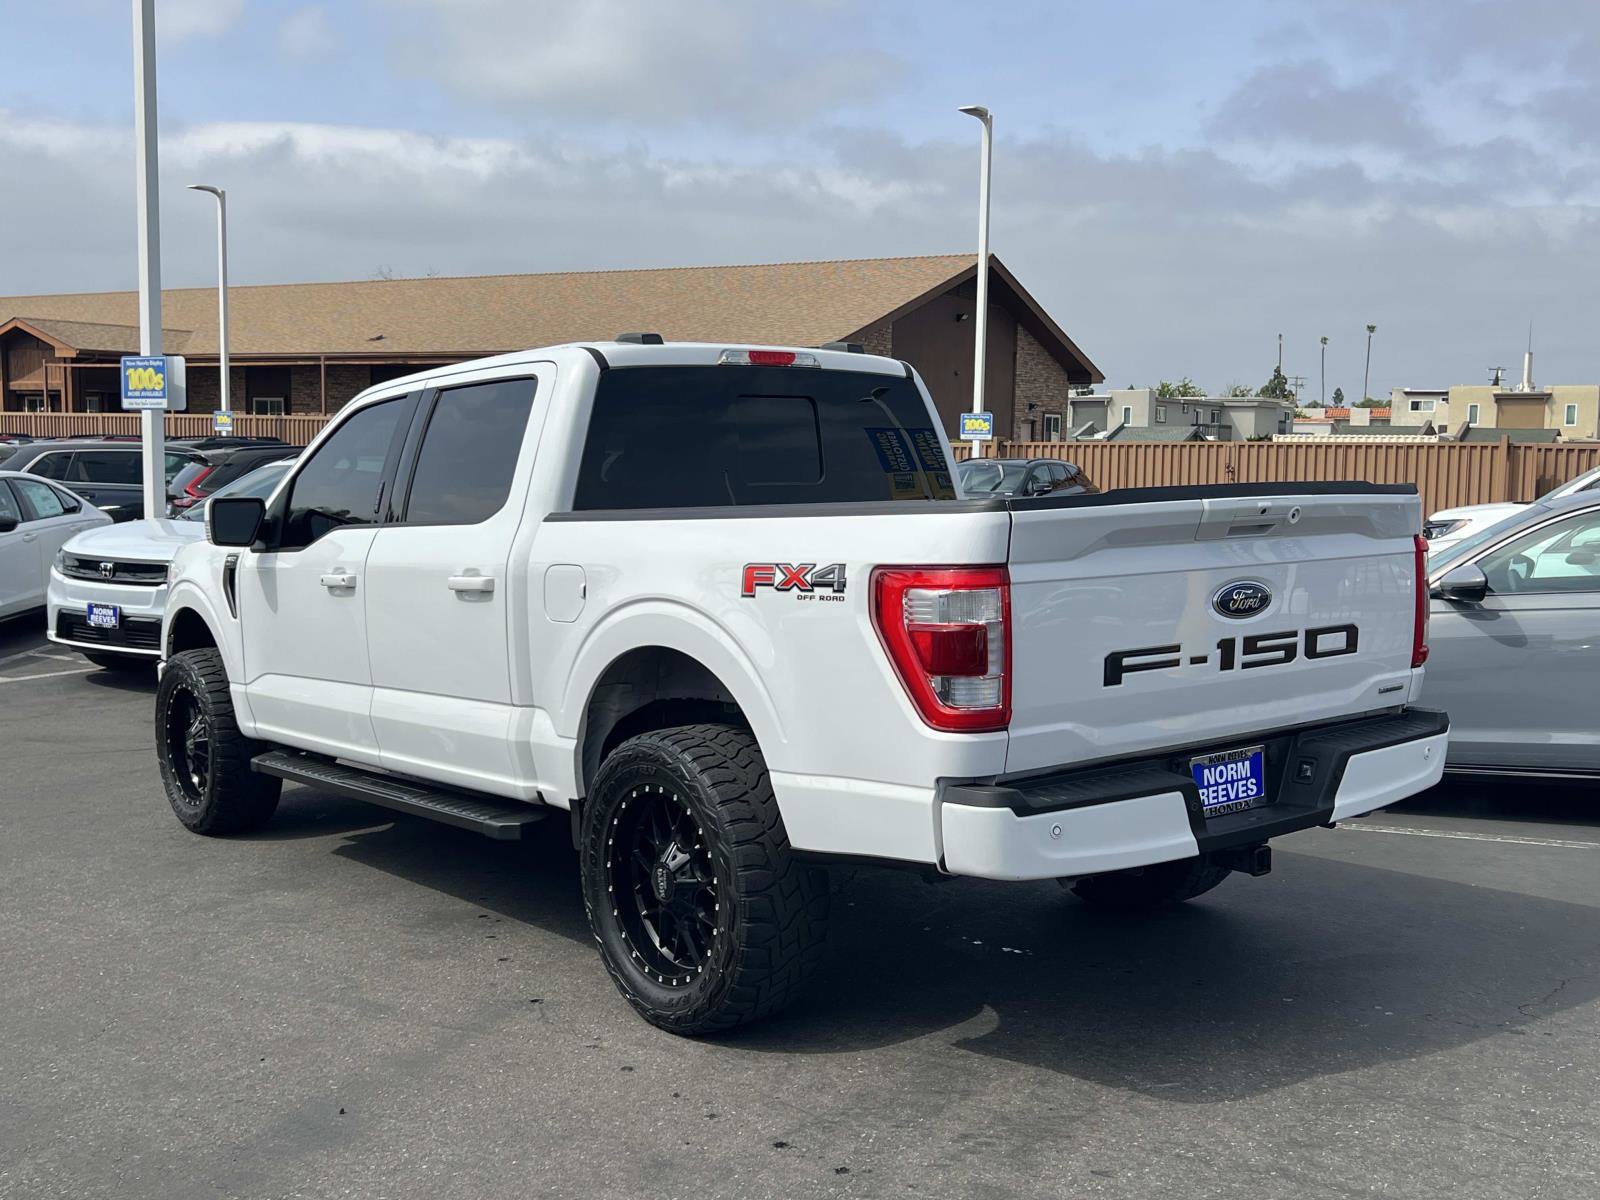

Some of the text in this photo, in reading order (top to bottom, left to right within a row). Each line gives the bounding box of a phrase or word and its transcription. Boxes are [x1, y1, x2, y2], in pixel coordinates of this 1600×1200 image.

[126, 367, 164, 391] 100s
[963, 419, 990, 431] 100s
[741, 562, 847, 598] FX4
[818, 594, 846, 602] ROAD
[1229, 589, 1262, 611] Ford
[93, 607, 114, 616] NORM
[1103, 623, 1359, 687] F-150
[1203, 761, 1251, 786] NORM
[1198, 778, 1257, 805] REEVES
